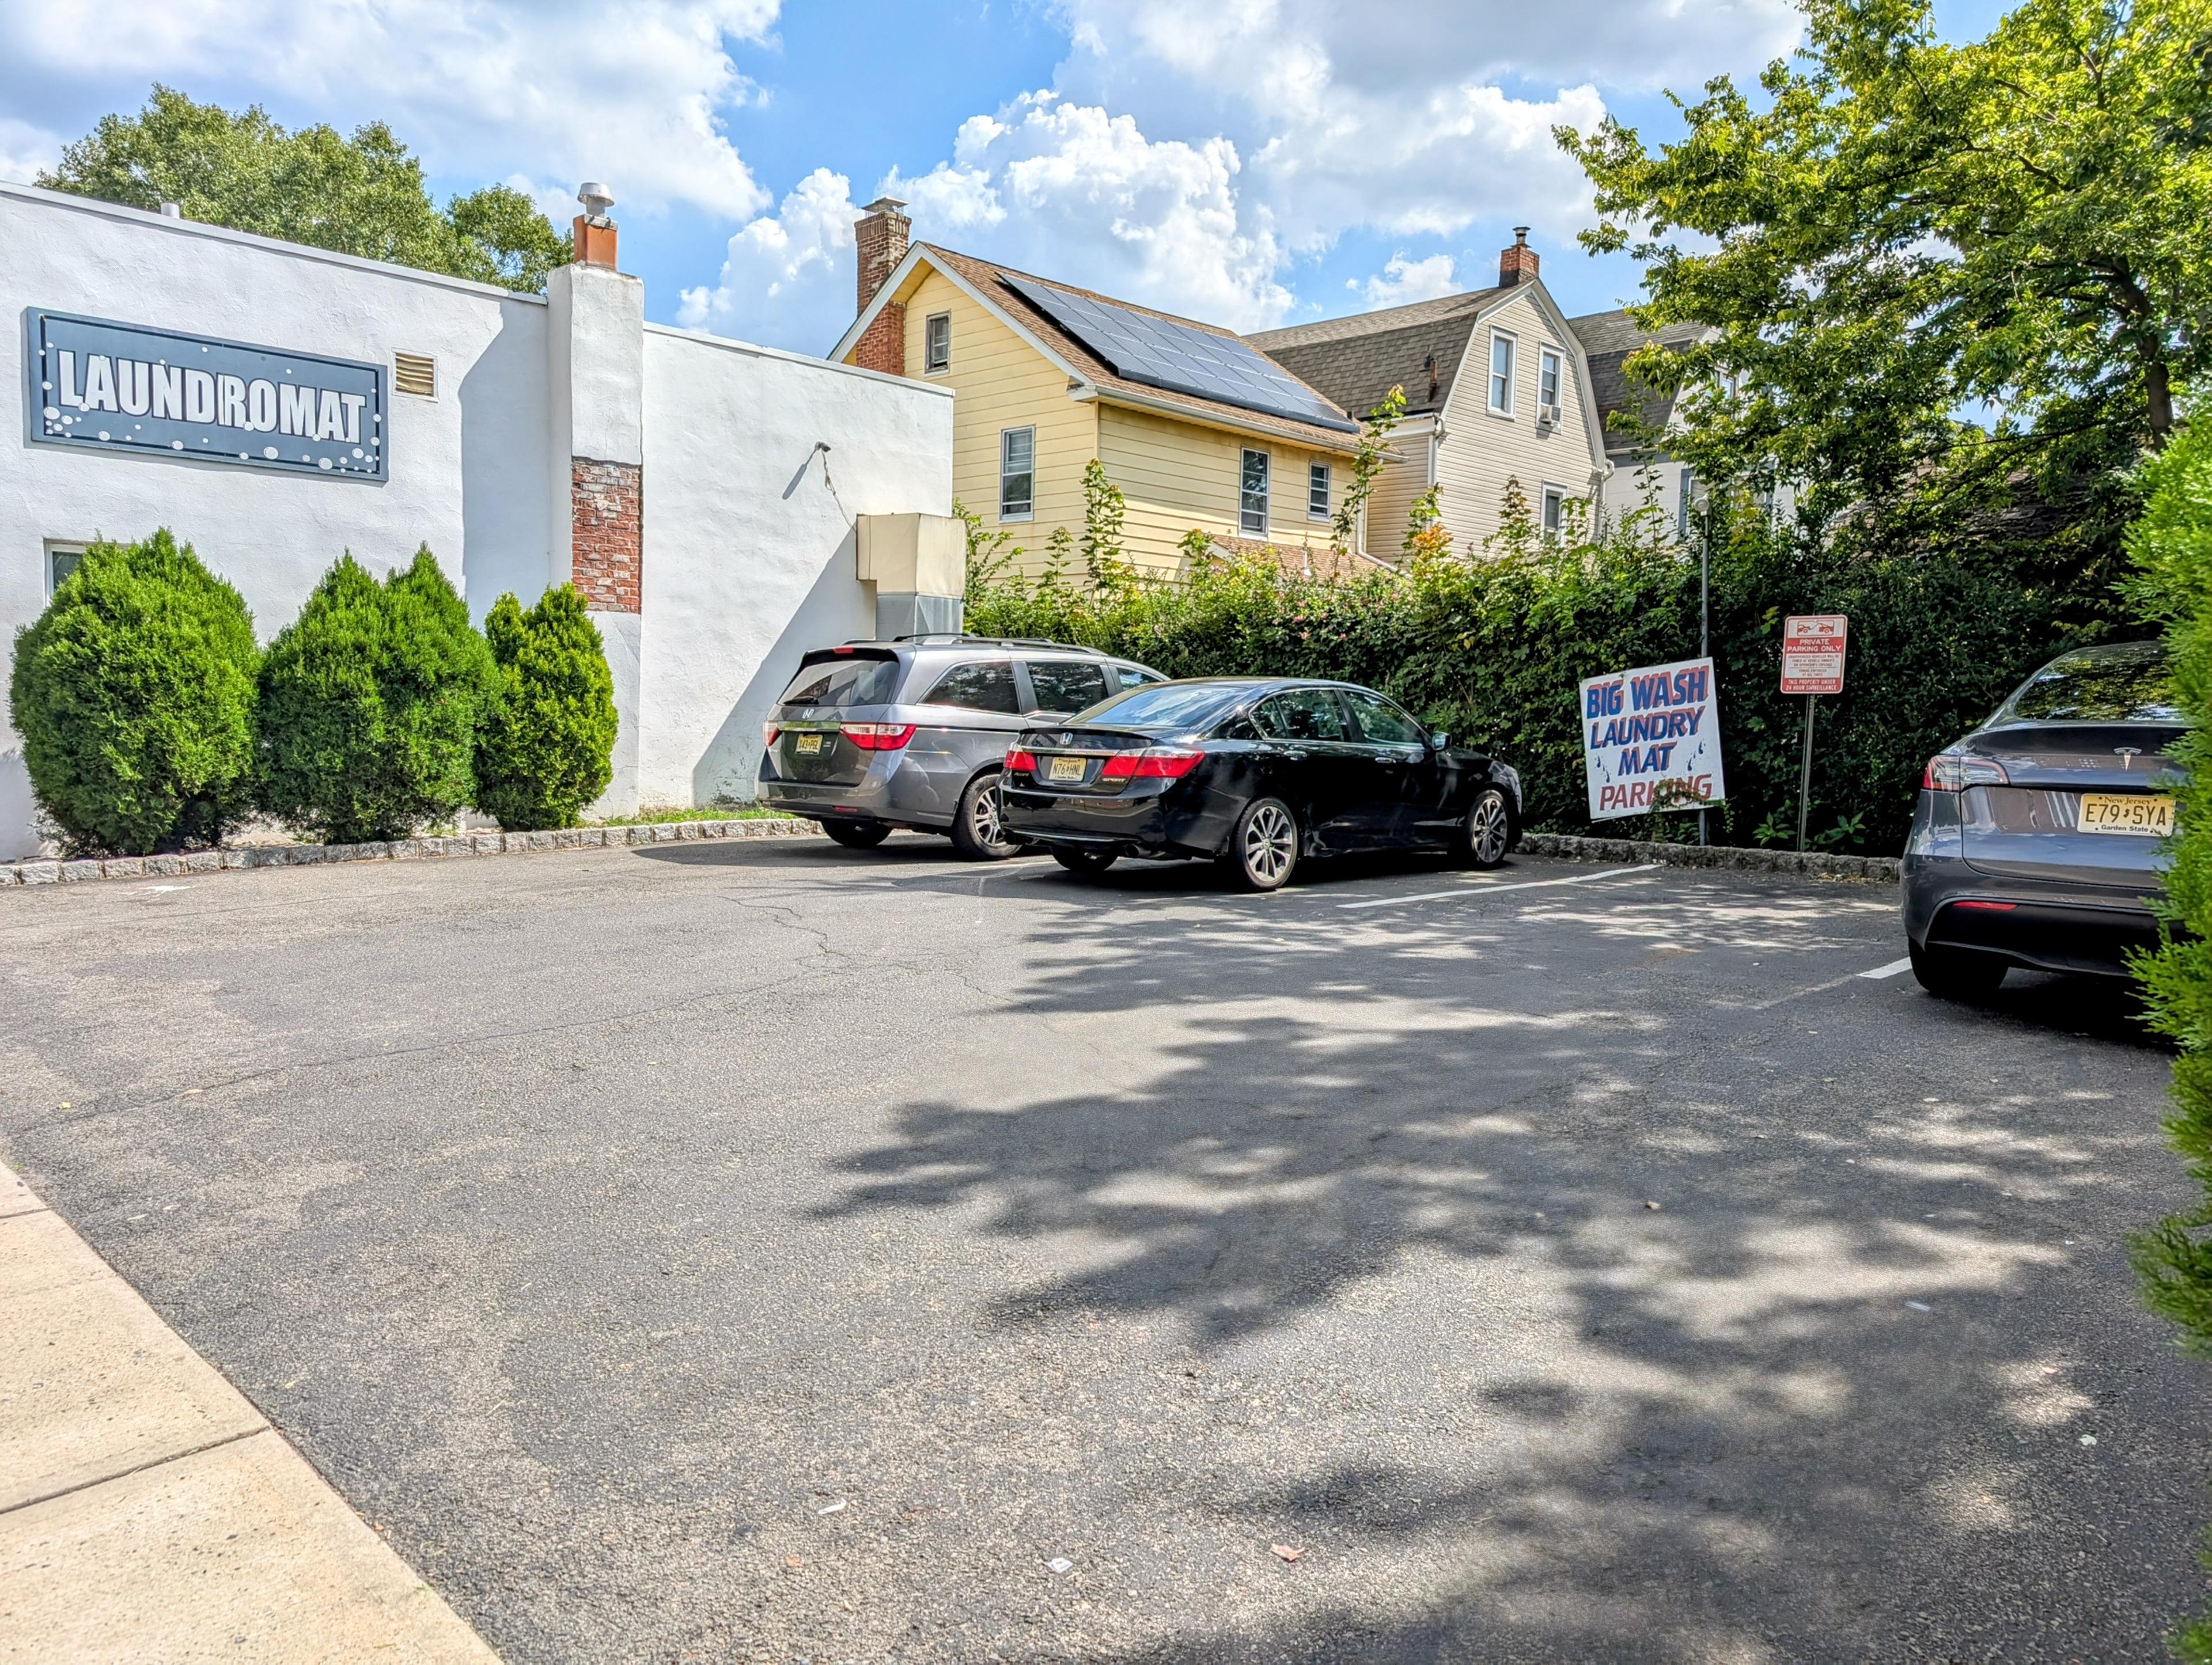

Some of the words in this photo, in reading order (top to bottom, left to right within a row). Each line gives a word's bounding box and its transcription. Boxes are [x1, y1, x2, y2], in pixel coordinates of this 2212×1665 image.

[58, 348, 366, 443] LAUNDROMAT
[1586, 680, 1624, 719] BIG
[1631, 665, 1710, 711] WASH
[1590, 706, 1706, 749] LAUNDRY
[1618, 741, 1677, 776] MAT
[2125, 797, 2152, 805] Jersey
